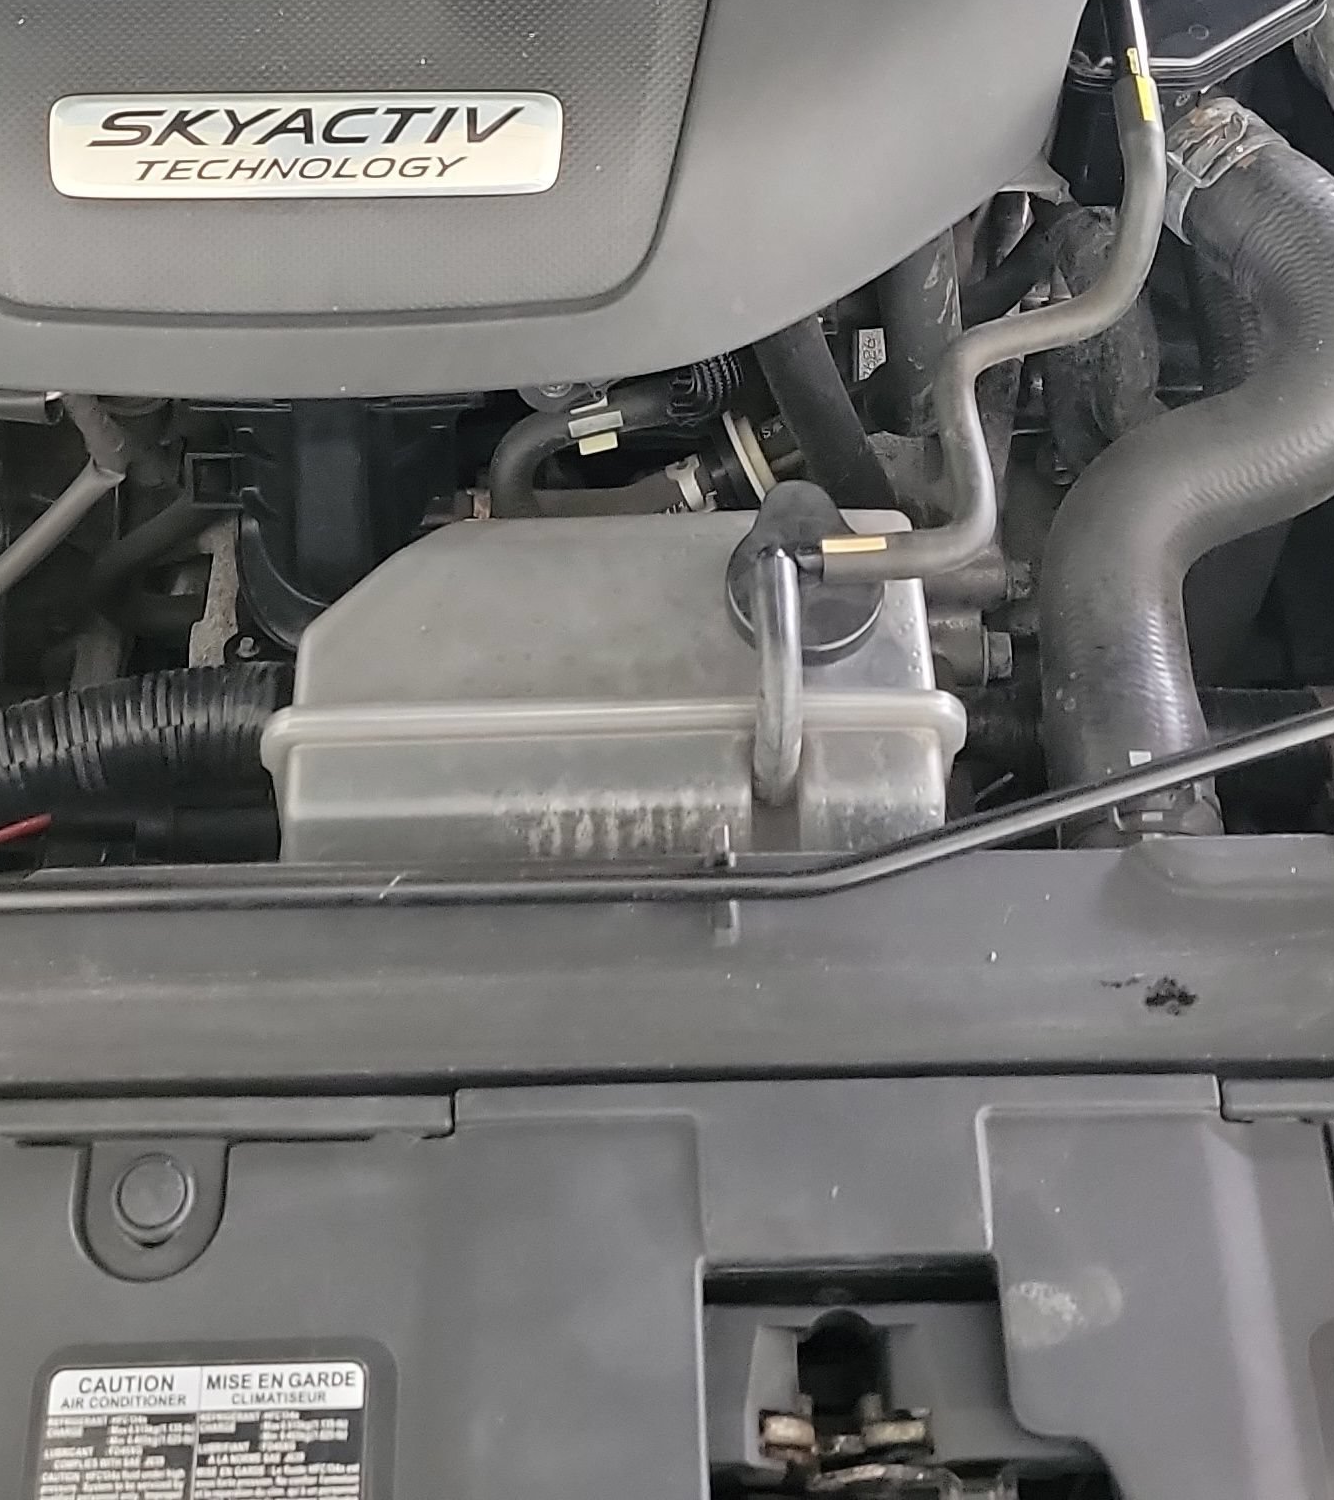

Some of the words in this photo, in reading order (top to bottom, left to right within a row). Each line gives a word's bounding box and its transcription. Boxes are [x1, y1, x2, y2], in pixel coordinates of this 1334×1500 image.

[86, 105, 524, 148] SKYACTIV
[134, 155, 468, 182] TECHNOLOGY
[78, 1374, 175, 1395] CAUTION
[206, 1373, 252, 1390] MISE
[258, 1372, 285, 1389] EN
[289, 1370, 356, 1388] GARDE
[61, 1397, 84, 1409] AIR
[89, 1394, 186, 1408] CONDITIONER
[231, 1390, 327, 1405] CLIMATISEUR
